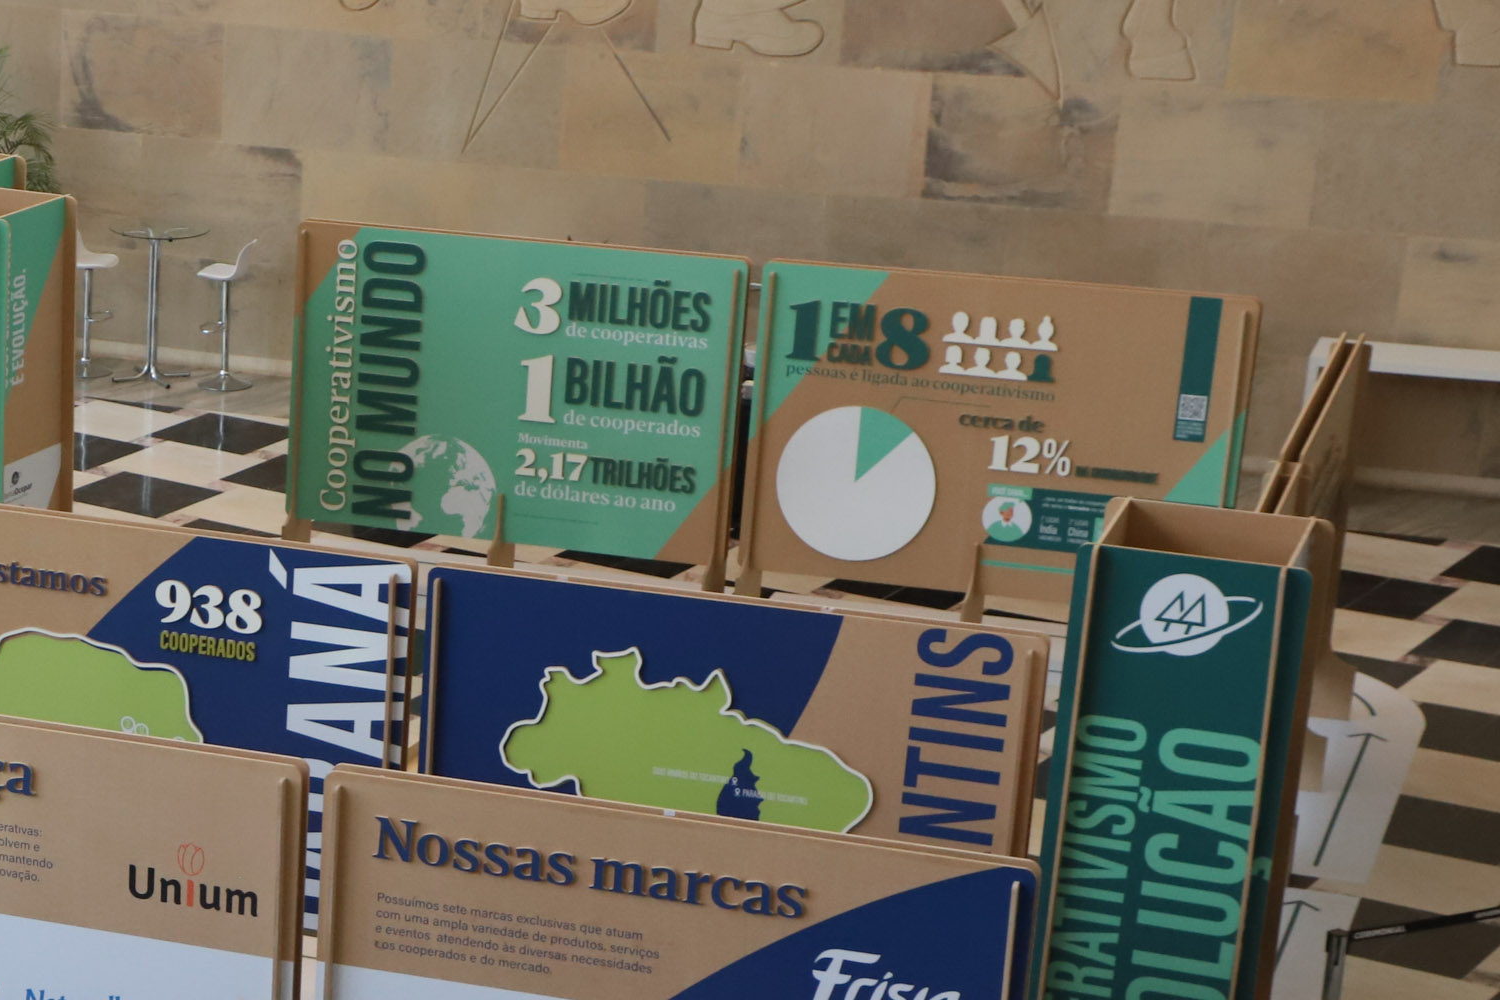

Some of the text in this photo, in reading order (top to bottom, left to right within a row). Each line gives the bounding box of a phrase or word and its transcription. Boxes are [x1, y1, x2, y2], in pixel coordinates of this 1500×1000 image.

[514, 276, 713, 336] 3 MILHÕES
[784, 299, 877, 363] 1 EM
[565, 322, 709, 351] de cooperativas
[826, 307, 932, 372] CADA 8
[319, 238, 359, 512] Cooperativismo
[350, 240, 427, 521] NO MUNDO
[517, 353, 707, 424] 1 BILHÃO
[785, 361, 1057, 404] pessoas é ligada ao cooperativismo
[517, 432, 589, 451] Movimenta
[562, 410, 701, 438] de cooperados
[957, 410, 1046, 434] cerca de
[514, 446, 697, 495] 2,17 TRILHÕES
[987, 434, 1072, 478] 12%
[514, 481, 676, 513] de dólares ao ano
[154, 577, 264, 636] 938
[159, 629, 257, 663] COOPERADOS
[127, 862, 260, 919] Unium
[372, 815, 810, 921] Nossas marcas
[376, 891, 644, 942] Possuímos sete marcas exclusivas que atuam
